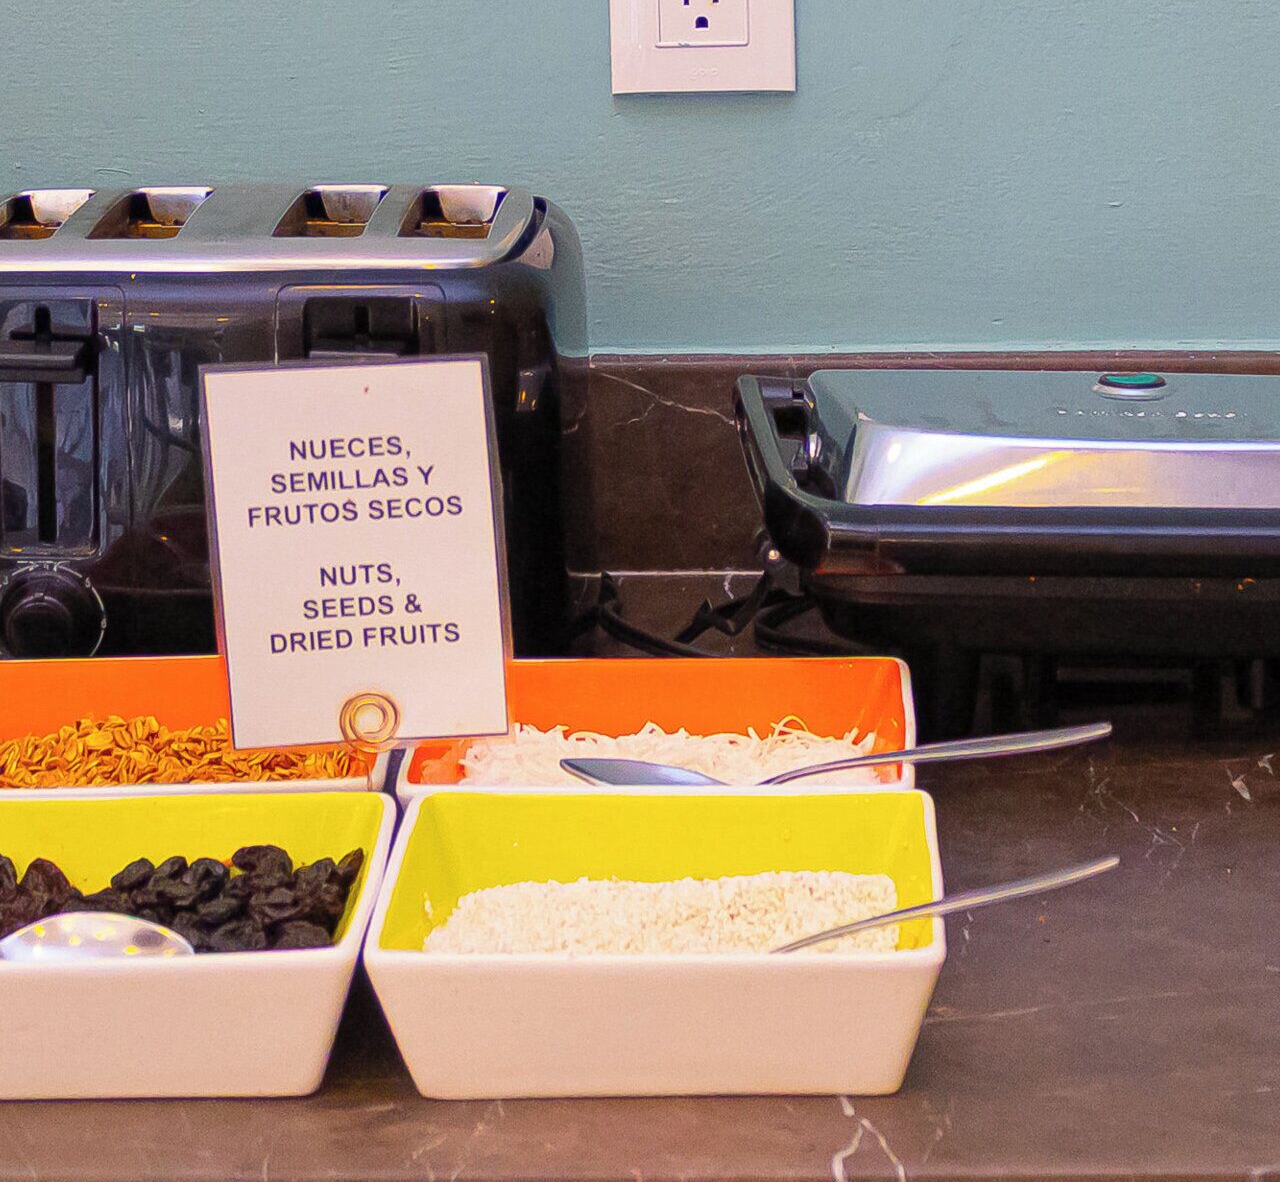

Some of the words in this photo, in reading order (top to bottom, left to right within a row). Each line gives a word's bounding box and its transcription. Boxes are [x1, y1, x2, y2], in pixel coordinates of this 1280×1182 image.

[290, 436, 410, 460] NUECES,
[271, 467, 408, 493] SEMILLAS
[417, 465, 433, 485] Y
[248, 501, 358, 527] FRUTOS
[369, 496, 462, 519] SECOS
[320, 563, 400, 587] NUTS,
[304, 595, 394, 619] SEEDS
[405, 594, 422, 613] &
[271, 629, 352, 654] DRIED
[363, 623, 460, 647] FRUITS
